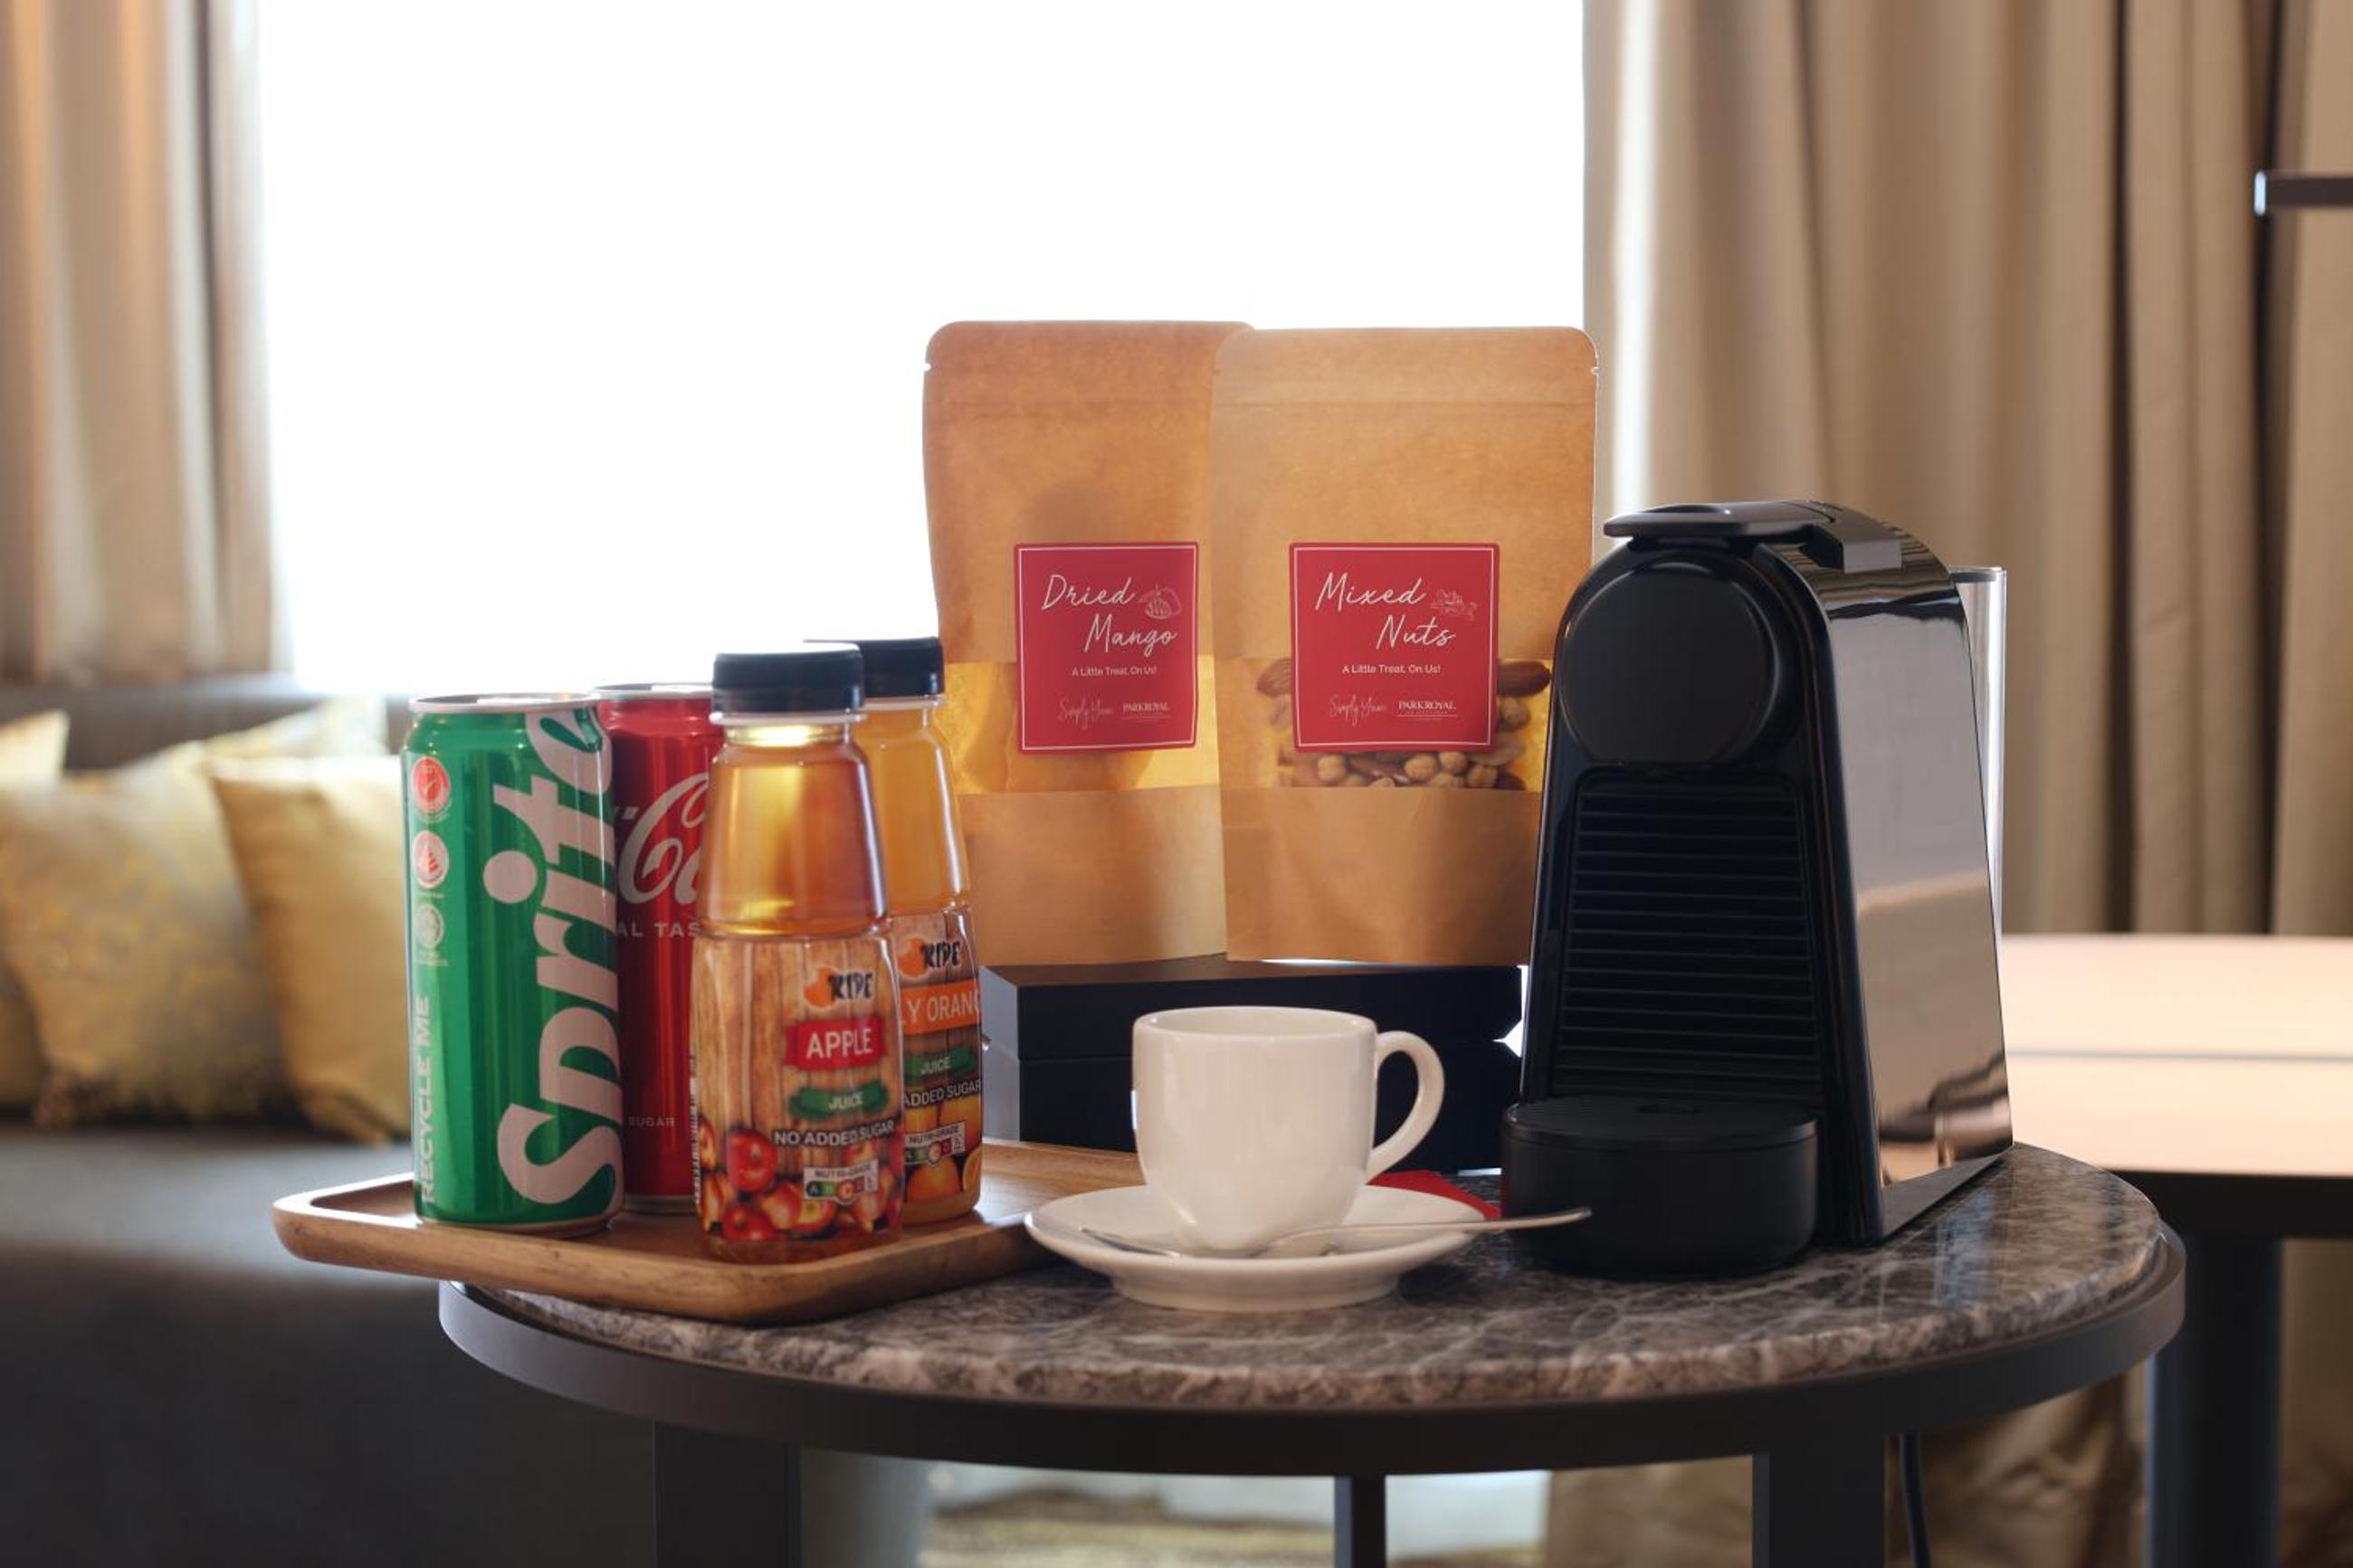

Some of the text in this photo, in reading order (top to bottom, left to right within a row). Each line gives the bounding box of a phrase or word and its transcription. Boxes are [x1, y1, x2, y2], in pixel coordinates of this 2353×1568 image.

[1042, 574, 1135, 611] Dried
[1315, 571, 1426, 613] Mixed
[1084, 613, 1178, 657] Mango
[1375, 613, 1456, 651] Nuts
[1072, 667, 1079, 677] A
[1130, 665, 1142, 675] On
[1342, 665, 1349, 674] A
[1351, 664, 1376, 674] Little
[1408, 664, 1423, 674] On
[1425, 664, 1441, 674] Us!
[483, 708, 624, 1212] Sprite
[805, 1028, 872, 1060] APPLE
[920, 1056, 951, 1075] JUICE
[415, 995, 435, 1204] RECYCLE ME
[828, 1090, 863, 1110] JUICE
[902, 1079, 981, 1106] ADDED SUGAR
[774, 1119, 894, 1146] NO ADDED SUGAR
